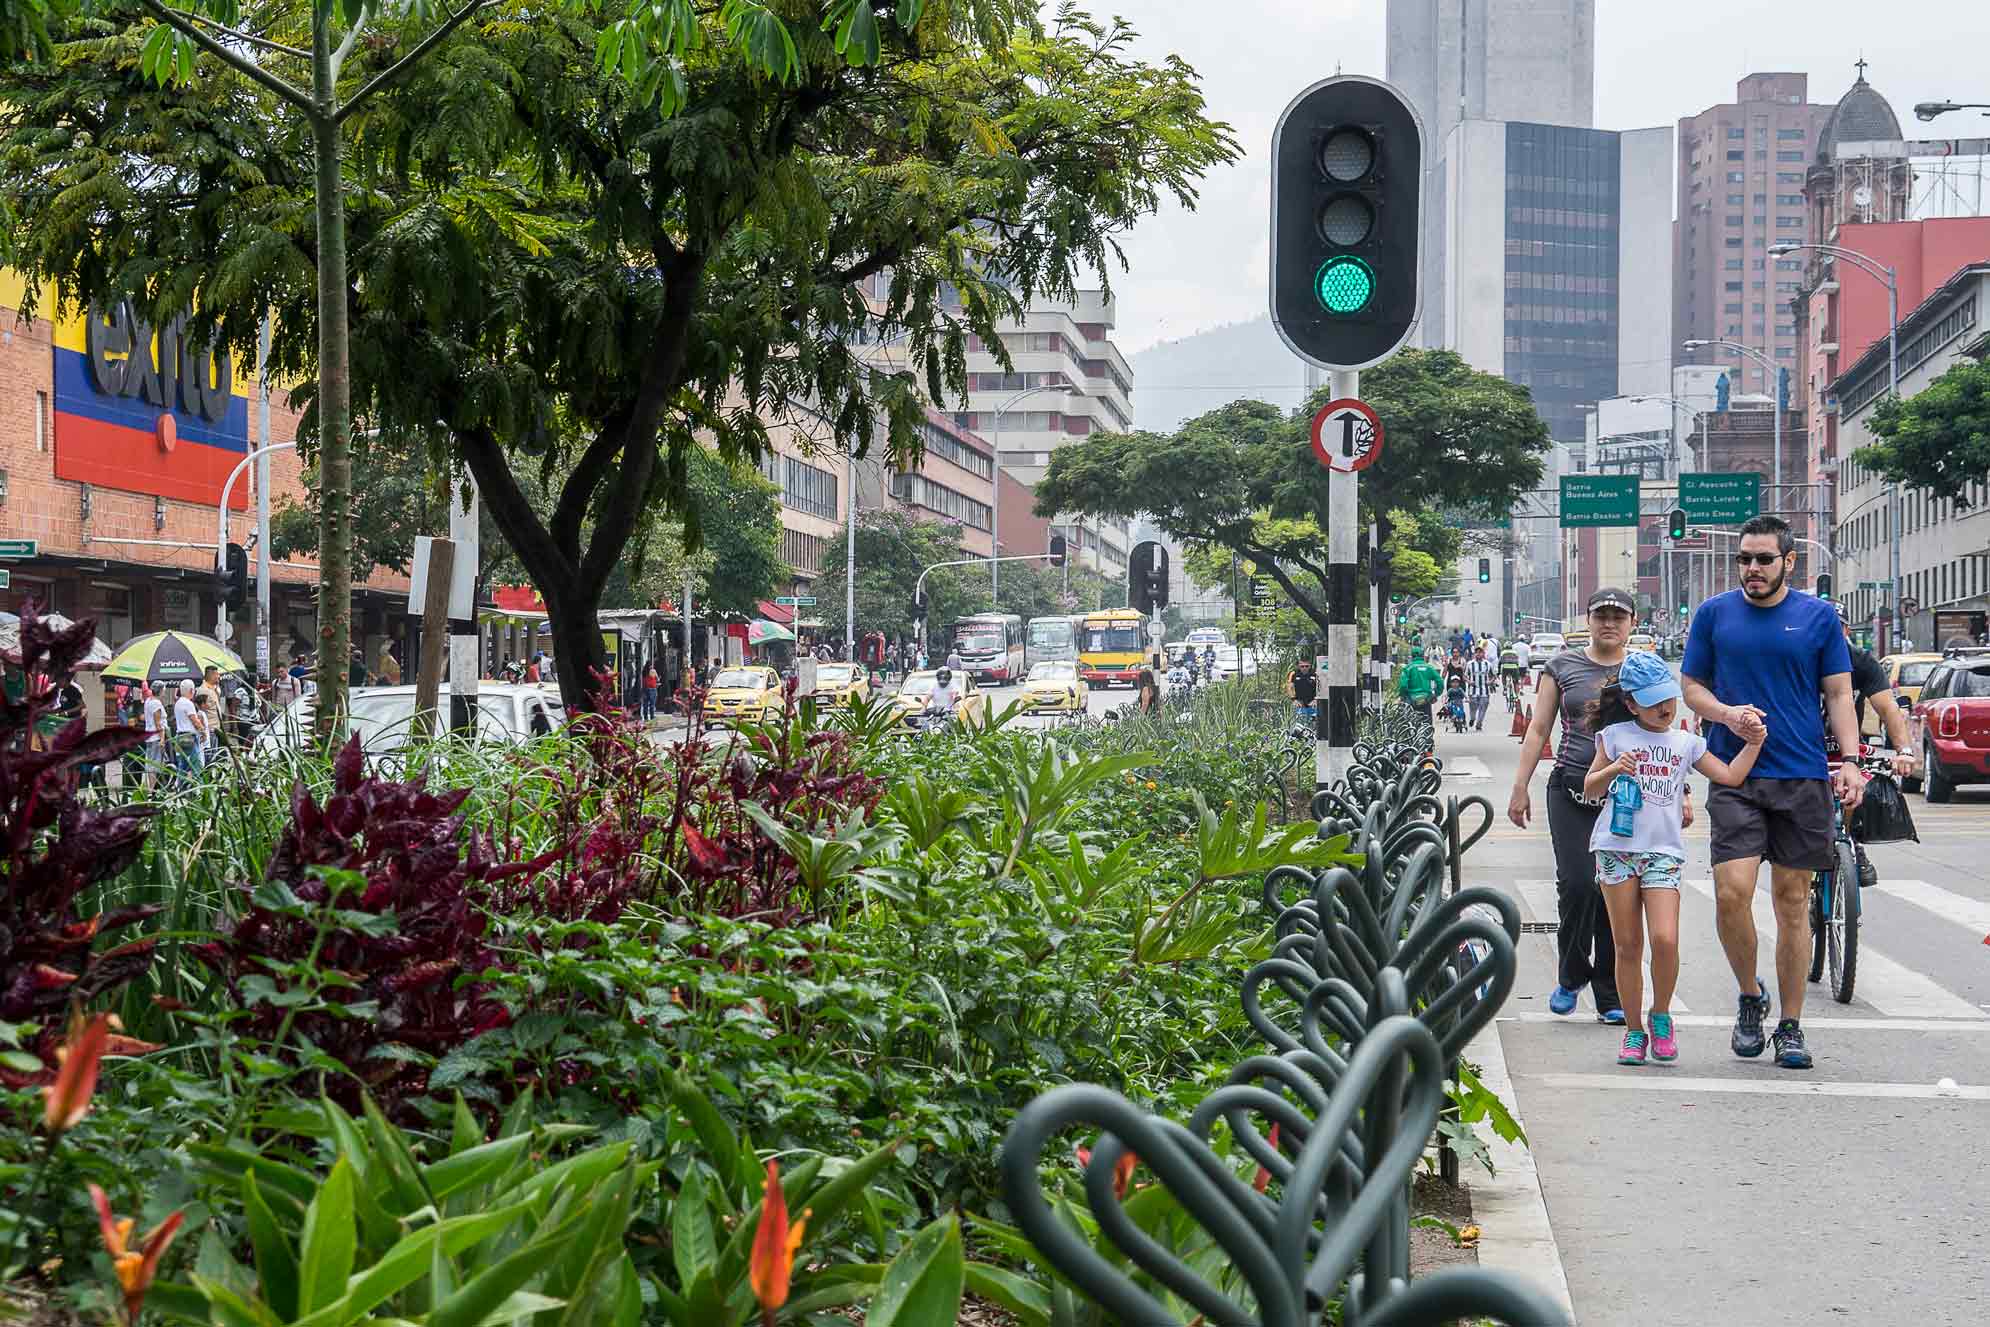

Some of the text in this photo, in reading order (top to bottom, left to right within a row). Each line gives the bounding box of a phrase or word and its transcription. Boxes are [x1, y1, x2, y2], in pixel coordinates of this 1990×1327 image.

[1566, 483, 1591, 491] Barrio
[1648, 745, 1672, 763] YOU
[1641, 776, 1672, 798] WORLD
